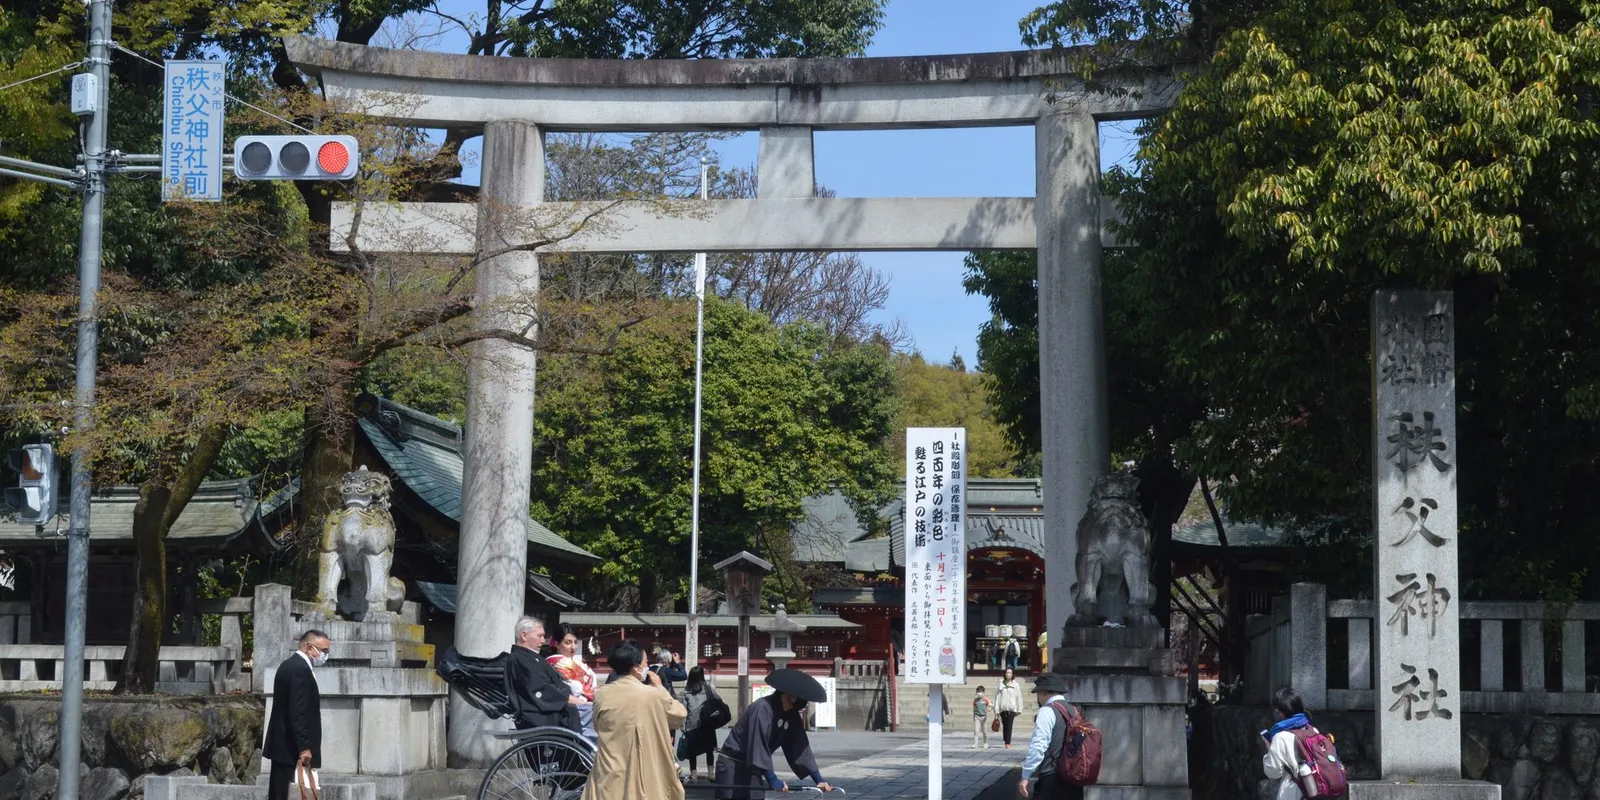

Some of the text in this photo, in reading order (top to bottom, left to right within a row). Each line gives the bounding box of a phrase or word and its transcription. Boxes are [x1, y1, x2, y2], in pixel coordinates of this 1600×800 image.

[170, 75, 185, 185] Chichibu Shrine
[183, 67, 211, 195] 秩父神社前
[212, 71, 223, 110] 秩父市
[914, 446, 927, 548] 甦る江戸の技術
[932, 440, 944, 541] 四百年の彩色
[1385, 410, 1453, 721] 秩父神社
